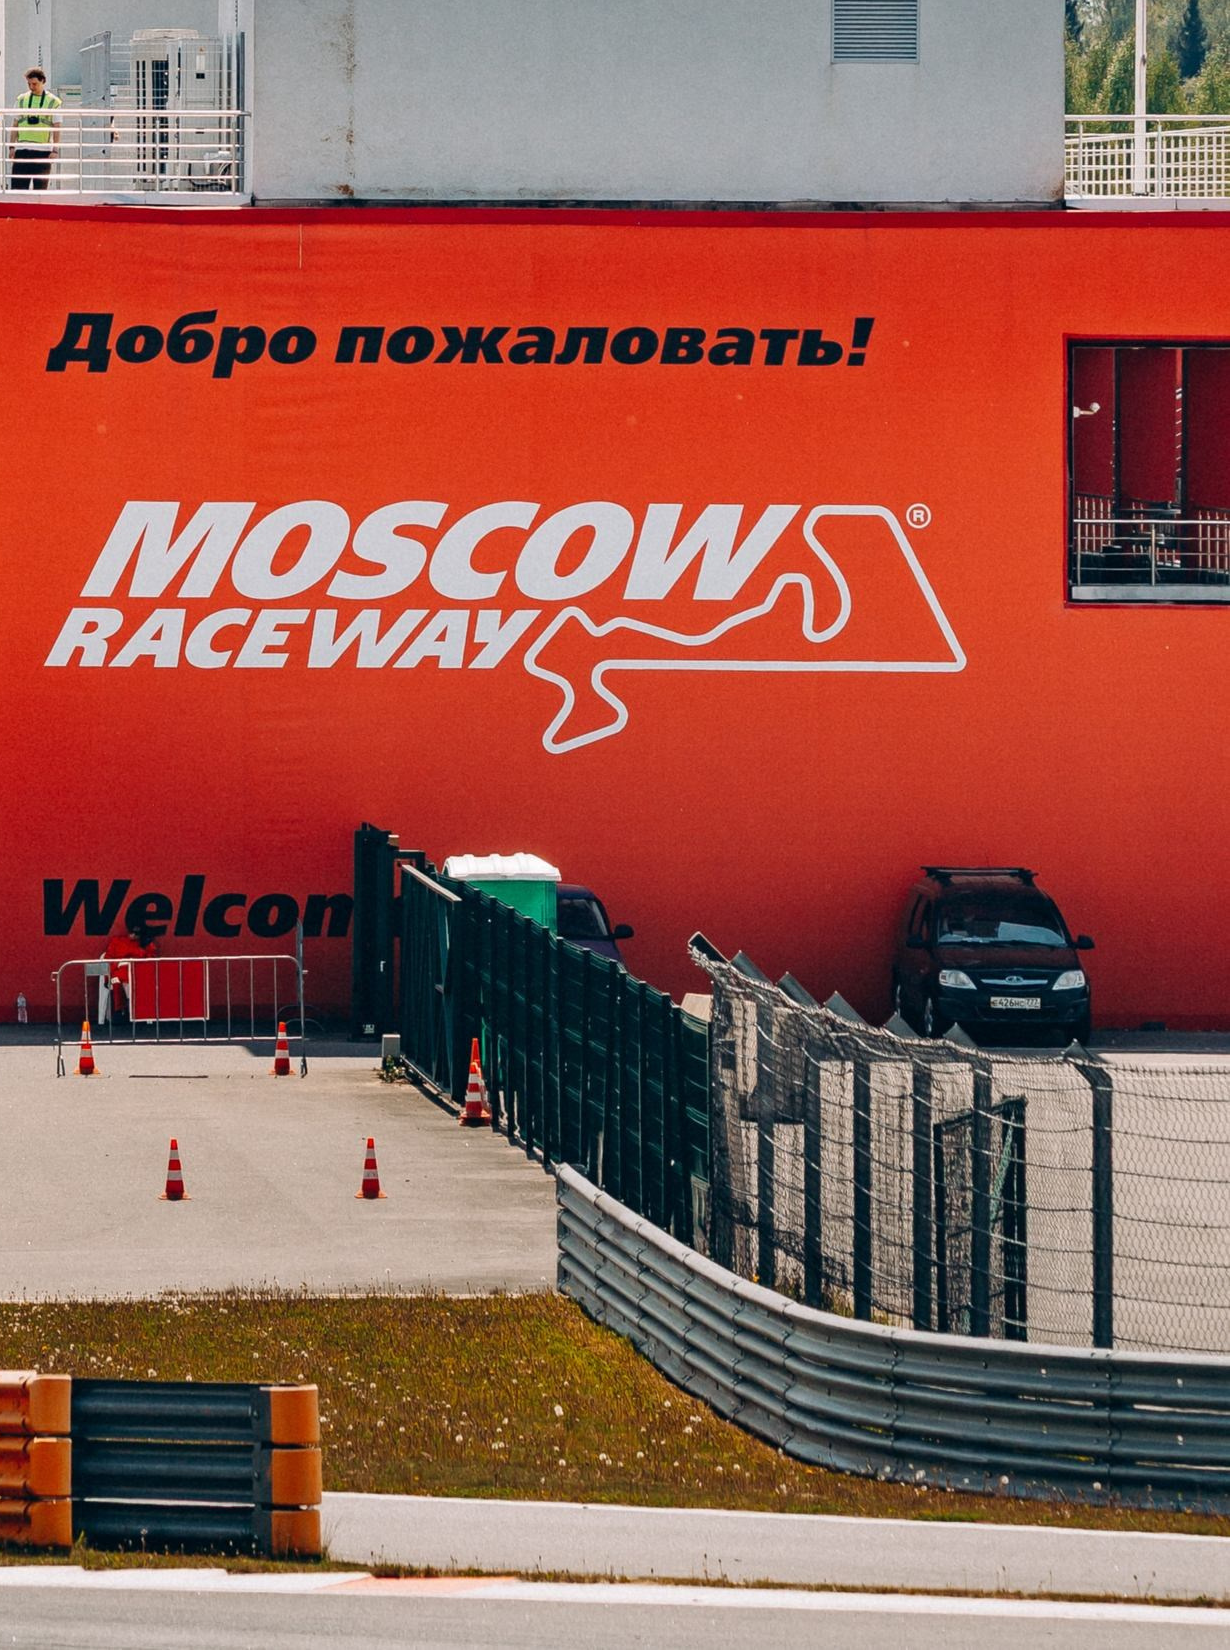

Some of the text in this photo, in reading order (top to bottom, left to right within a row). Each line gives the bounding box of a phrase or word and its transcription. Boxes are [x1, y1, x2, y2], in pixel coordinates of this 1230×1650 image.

[46, 309, 874, 379] Добро пожаловать!
[81, 500, 801, 600] MOSCOW
[45, 607, 540, 671] RACEWAY
